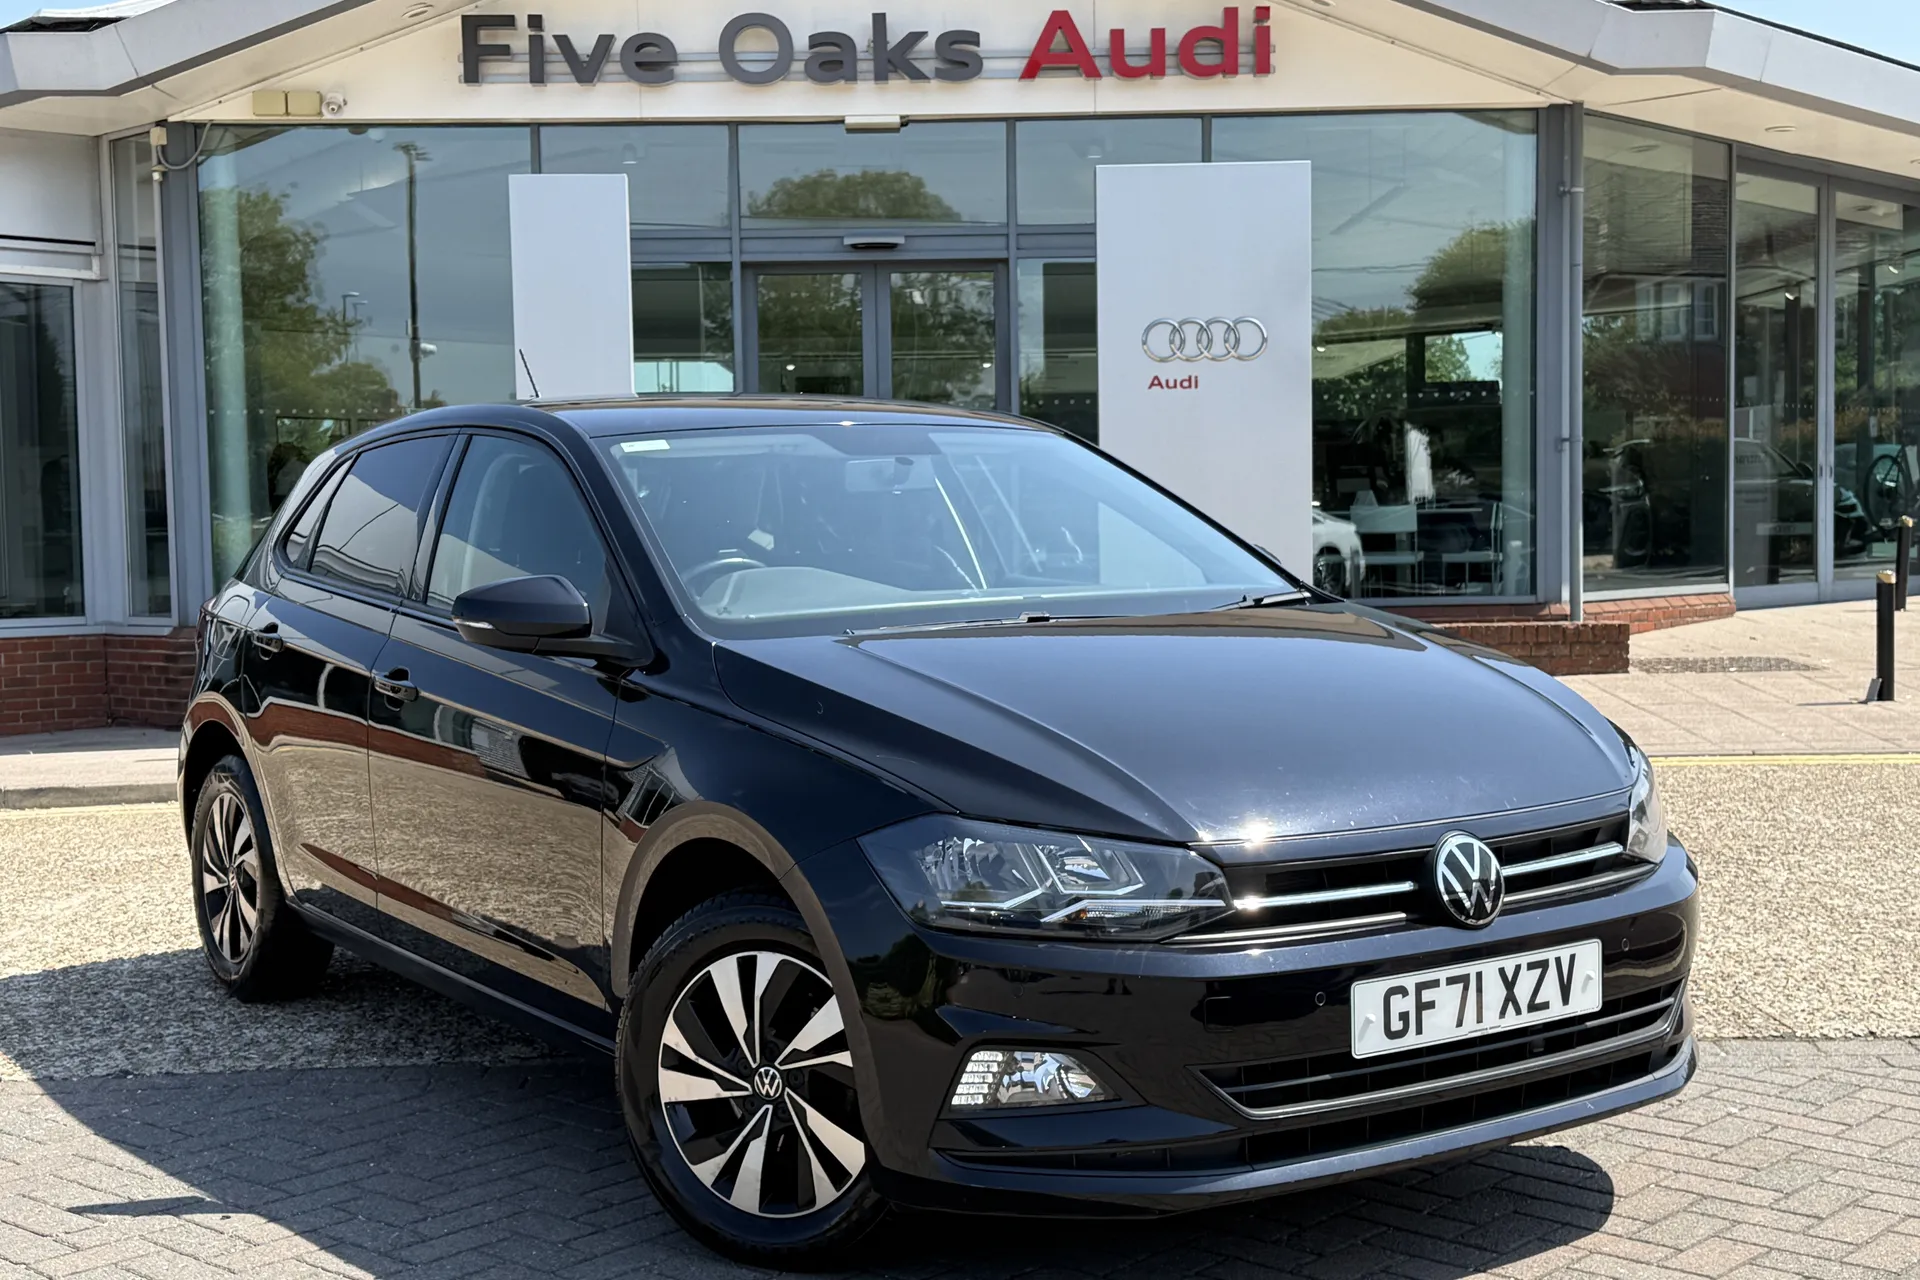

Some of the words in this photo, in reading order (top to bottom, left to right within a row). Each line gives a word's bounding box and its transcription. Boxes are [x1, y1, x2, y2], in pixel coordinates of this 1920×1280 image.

[461, 14, 679, 86] Five
[718, 12, 984, 85] Oaks
[1019, 6, 1271, 81] Audi
[1147, 374, 1199, 390] Audi
[1437, 835, 1502, 921] VW
[1383, 971, 1484, 1040] GF71
[1498, 953, 1577, 1020] XZV
[755, 1067, 782, 1099] VW
